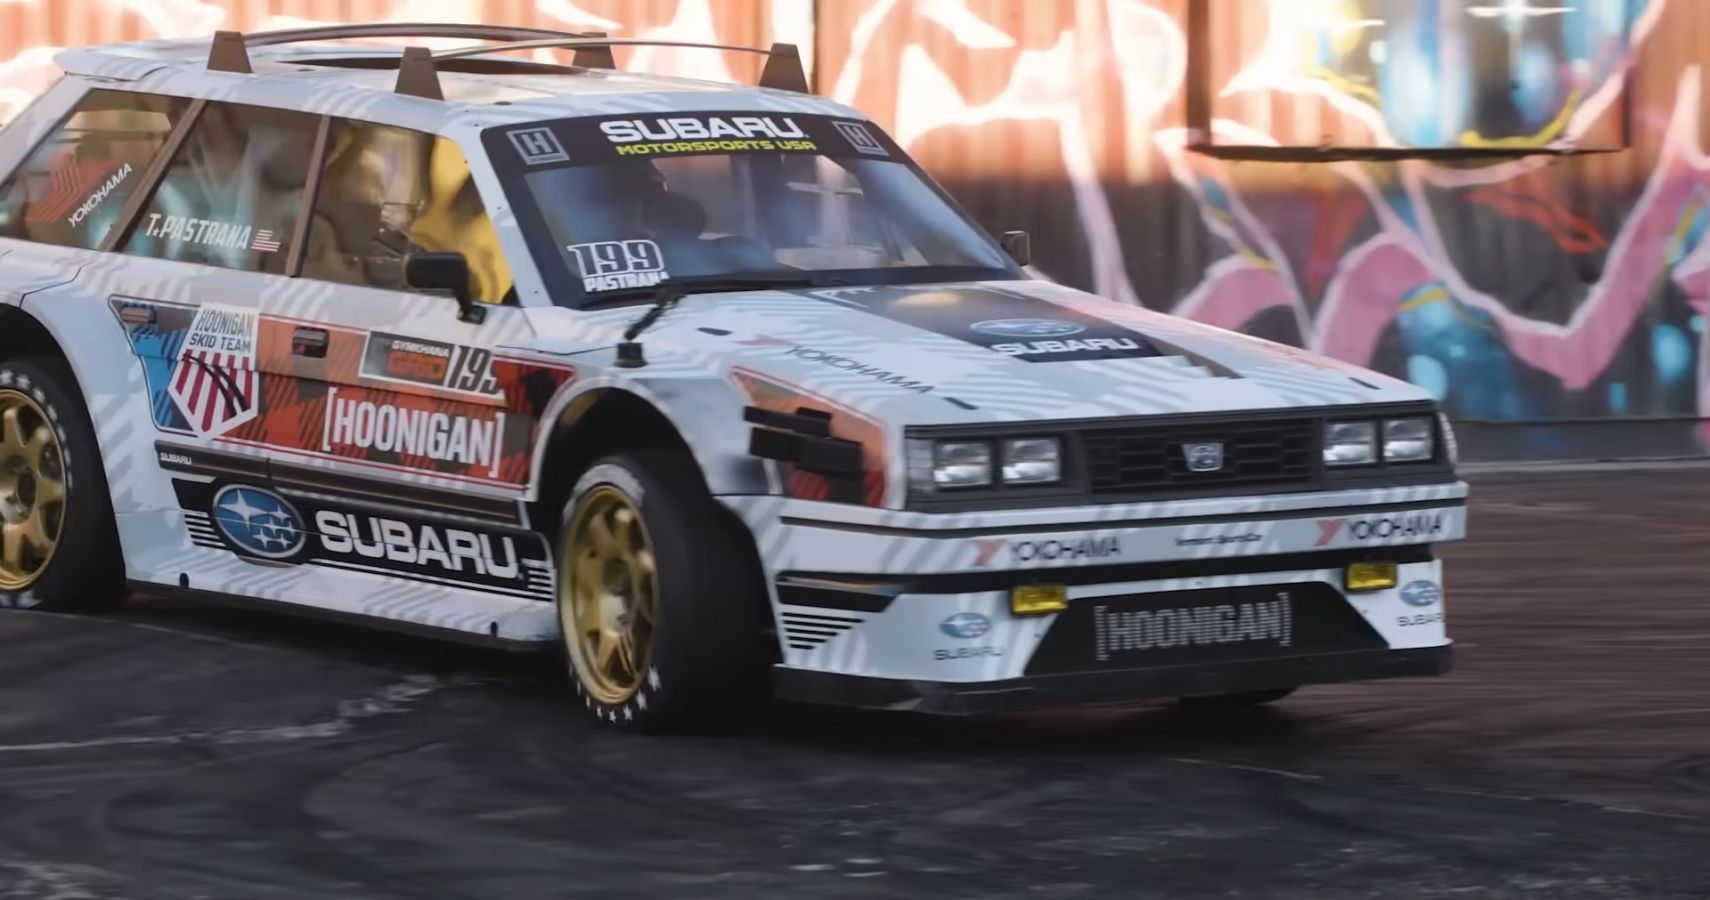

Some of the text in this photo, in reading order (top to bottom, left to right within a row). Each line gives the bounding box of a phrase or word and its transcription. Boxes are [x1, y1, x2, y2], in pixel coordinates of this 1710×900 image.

[600, 117, 805, 142] SUBARU
[616, 140, 817, 155] MOTORSPORTS USA
[67, 163, 133, 227] YOKOHAMA
[566, 240, 665, 278] 199
[194, 308, 255, 337] HOONIGAN
[189, 332, 252, 352] SKID TEAM
[991, 338, 1140, 356] SUBARU
[784, 346, 935, 393] YOKOHAMA
[160, 452, 192, 465] SUBARU
[1348, 513, 1442, 540] YOKOHAMA
[315, 510, 519, 579] SUBARU
[1010, 537, 1122, 561] YOKOHAMA
